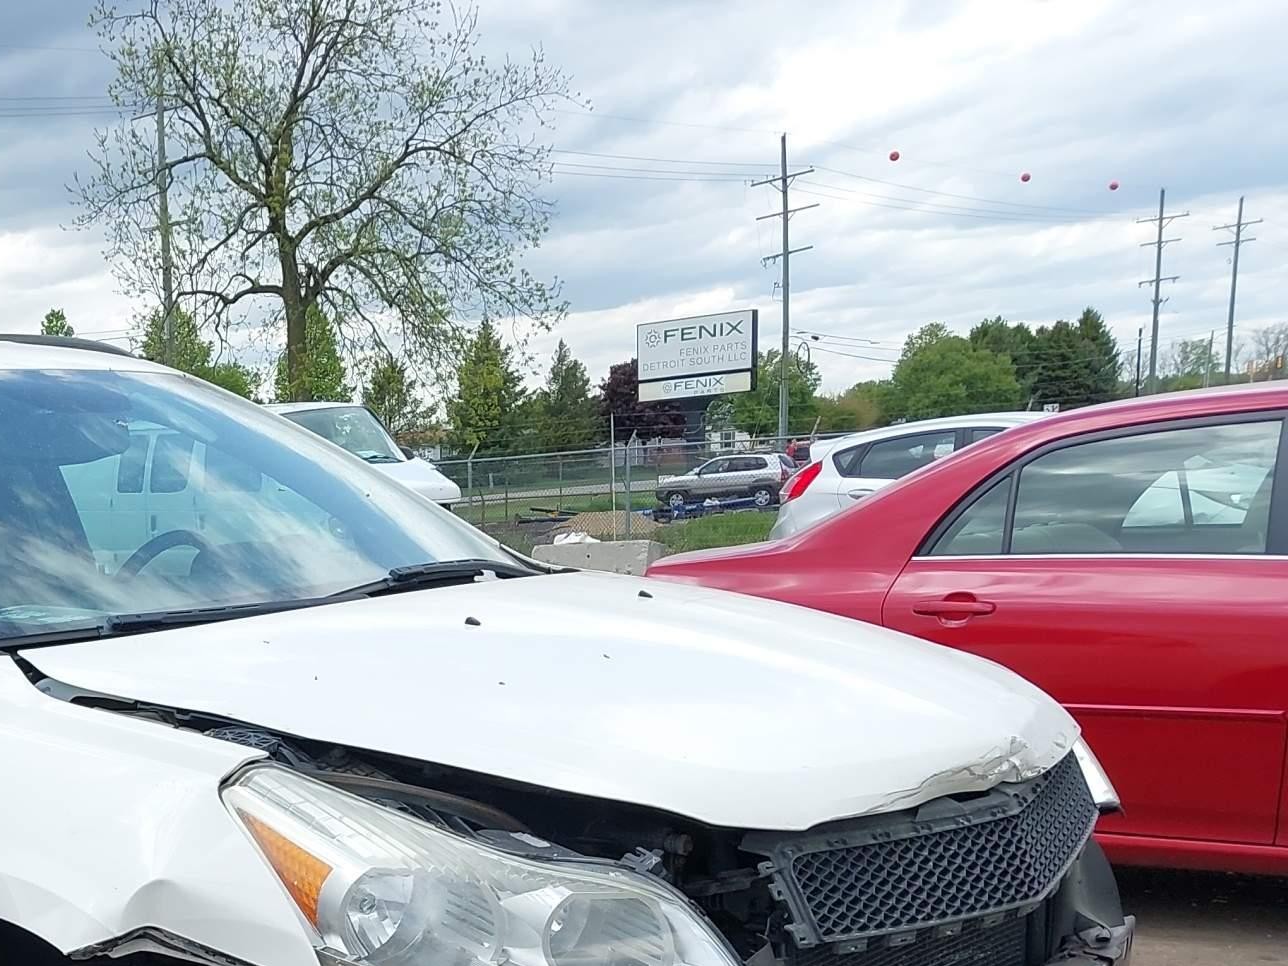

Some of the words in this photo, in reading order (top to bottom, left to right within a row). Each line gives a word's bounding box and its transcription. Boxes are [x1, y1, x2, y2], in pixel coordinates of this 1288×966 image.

[663, 319, 744, 344] FENIX
[679, 345, 710, 357] FENIX
[712, 341, 747, 353] PARTS
[642, 358, 685, 372] DETROIT
[688, 354, 724, 366] SOUTH
[728, 351, 747, 362] LLC
[673, 376, 725, 391] FENIX
